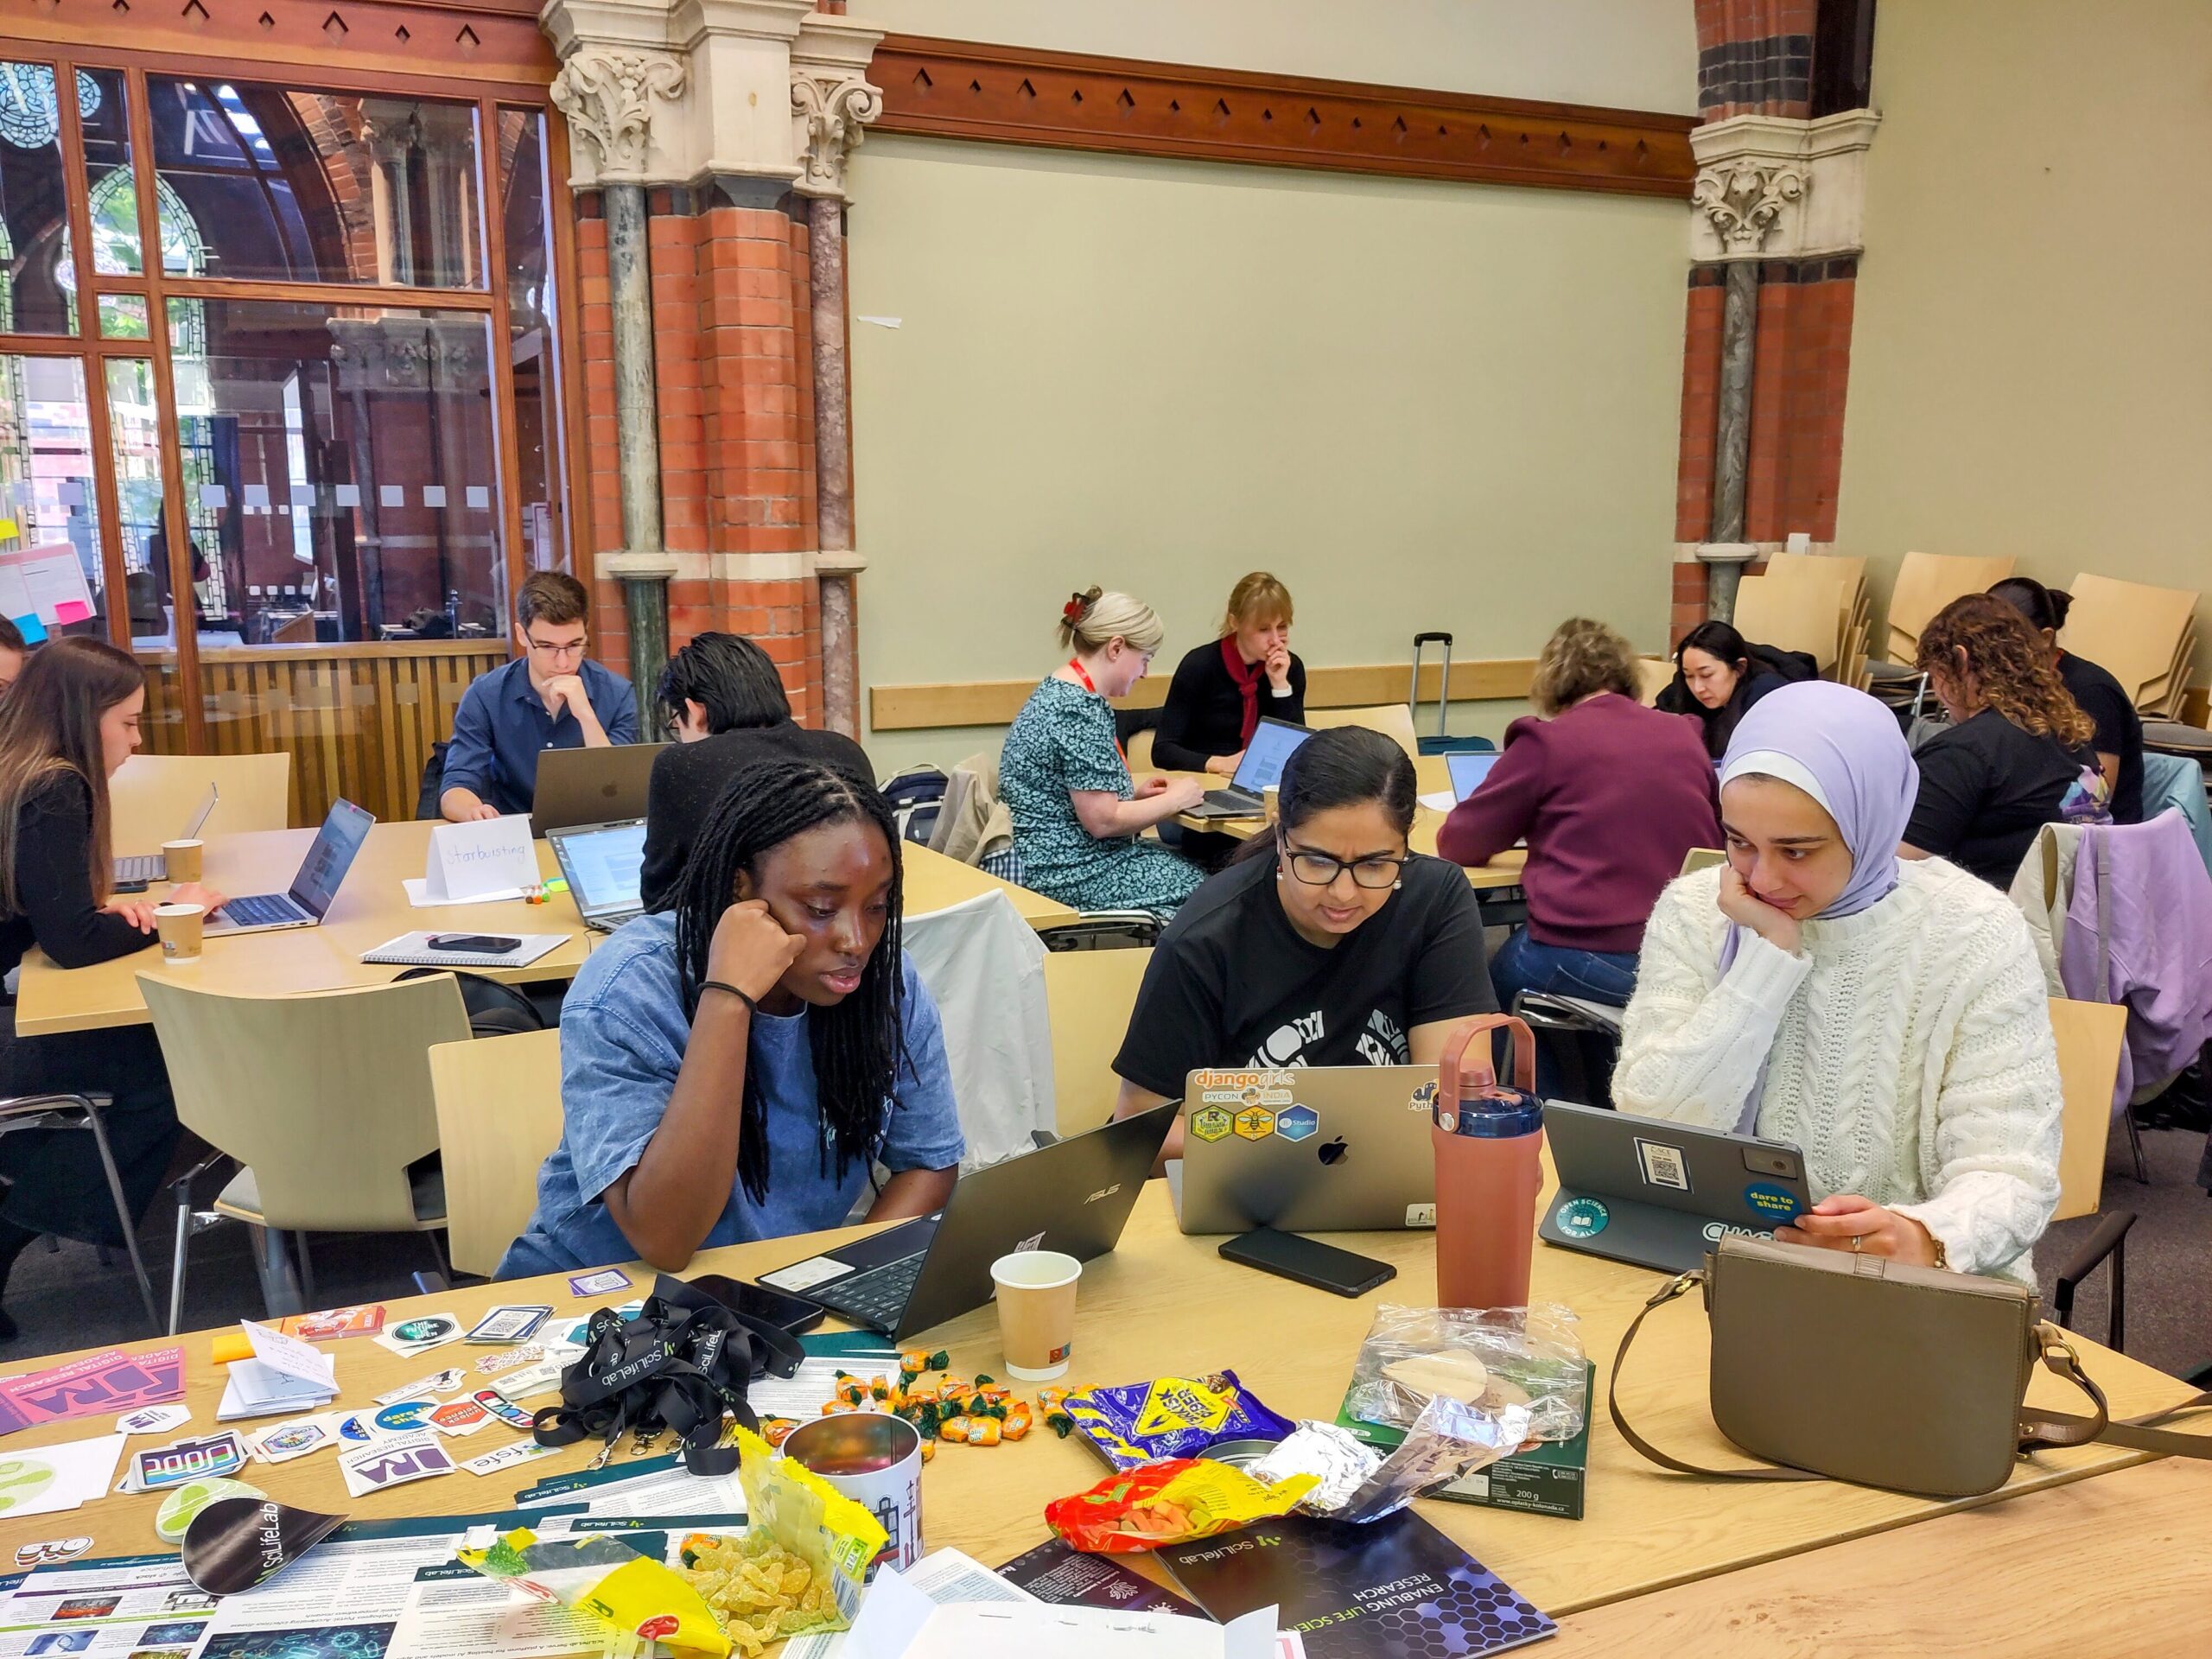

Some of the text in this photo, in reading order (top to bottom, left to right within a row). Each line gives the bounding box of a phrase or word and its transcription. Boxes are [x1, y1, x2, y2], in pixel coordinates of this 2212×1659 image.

[1409, 1102, 1433, 1110] Pyth
[1750, 1192, 1778, 1202] dare
[1560, 1198, 1607, 1217] OPEN SCIENCE
[1756, 1199, 1791, 1211] share
[1560, 1225, 1596, 1237] FOR ALL
[138, 1353, 180, 1367] DIGITA
[601, 1349, 663, 1388] SciLifeLab
[524, 1484, 570, 1499] SciLifeLab
[1516, 1490, 1532, 1499] 200
[1533, 1492, 1540, 1501] g
[260, 1502, 283, 1569] SciLifeLab
[1179, 1541, 1255, 1566] SciLifeLab
[424, 1567, 476, 1577] SciLifeLab
[1352, 1573, 1432, 1602] RESEARCH
[1285, 1582, 1444, 1633] ENABLING LIFE SCIEN
